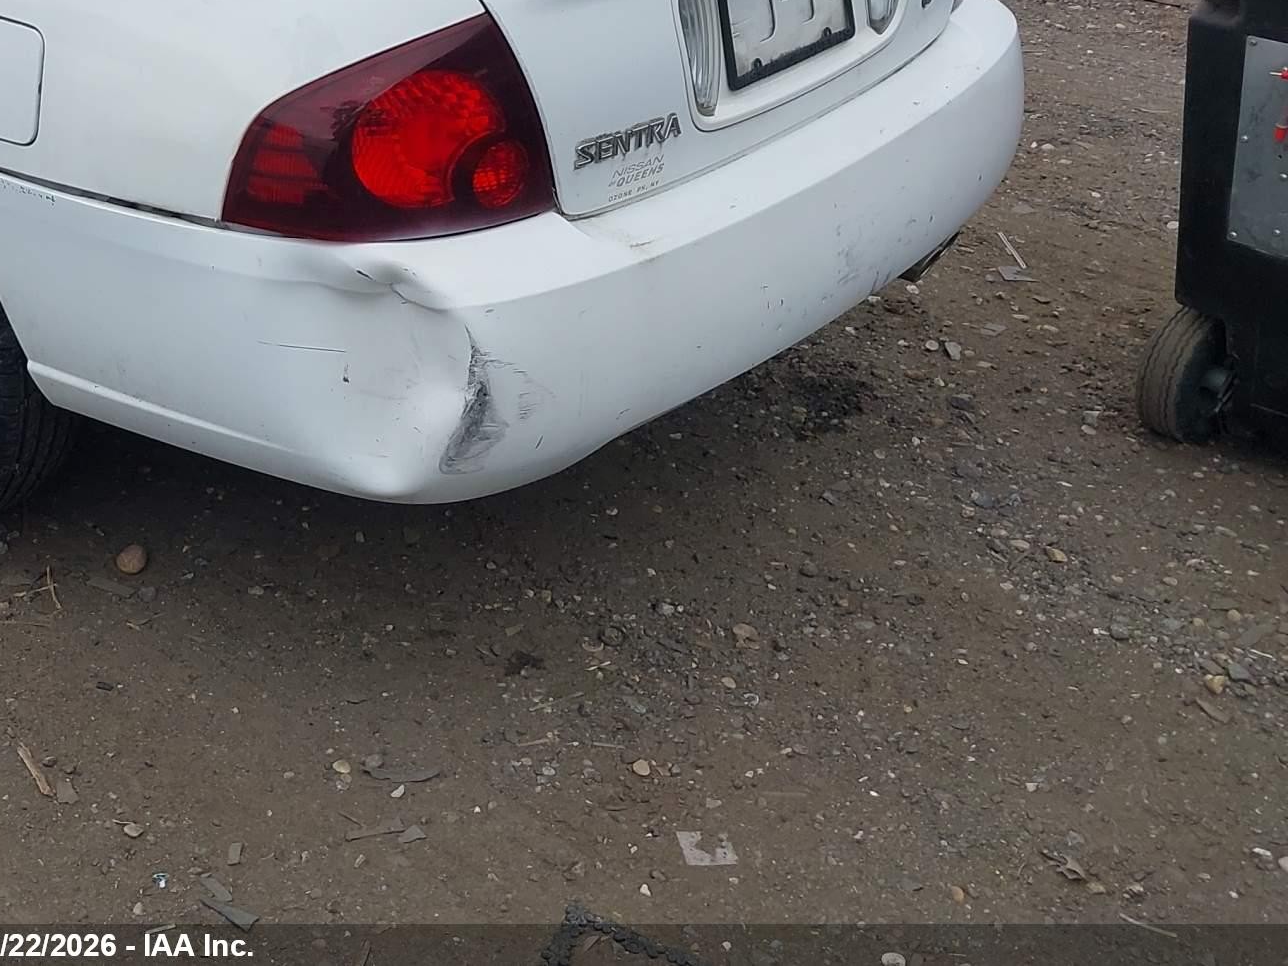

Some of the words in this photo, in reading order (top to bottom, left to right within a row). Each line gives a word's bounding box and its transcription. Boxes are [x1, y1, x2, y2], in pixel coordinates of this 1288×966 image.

[573, 112, 682, 171] SENTRA
[612, 154, 665, 179] NISSAN
[616, 162, 665, 188] QUEENS
